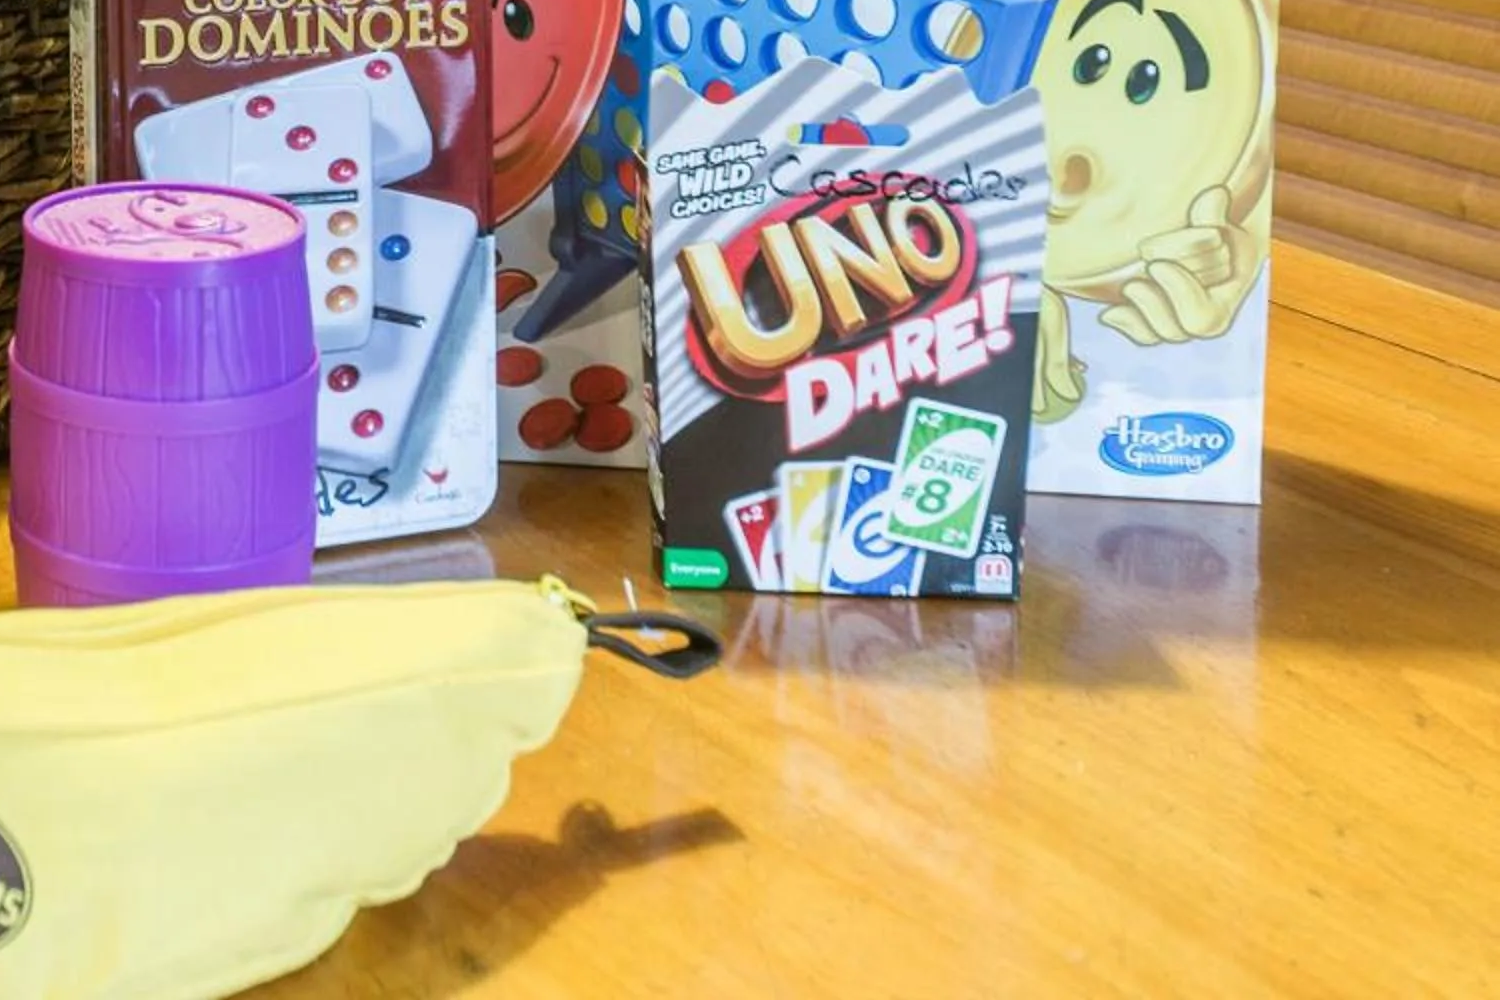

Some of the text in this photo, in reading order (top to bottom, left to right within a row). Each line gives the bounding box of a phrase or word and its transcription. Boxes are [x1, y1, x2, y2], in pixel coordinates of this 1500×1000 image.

[137, 0, 471, 68] DOMINOES
[677, 160, 755, 200] WILD
[670, 184, 766, 219] CHOICES!
[677, 198, 961, 371] UNO
[785, 274, 1017, 453] DARE!
[1102, 415, 1226, 454] Hasbro
[919, 455, 981, 483] DARE
[669, 563, 721, 577] Everyone
